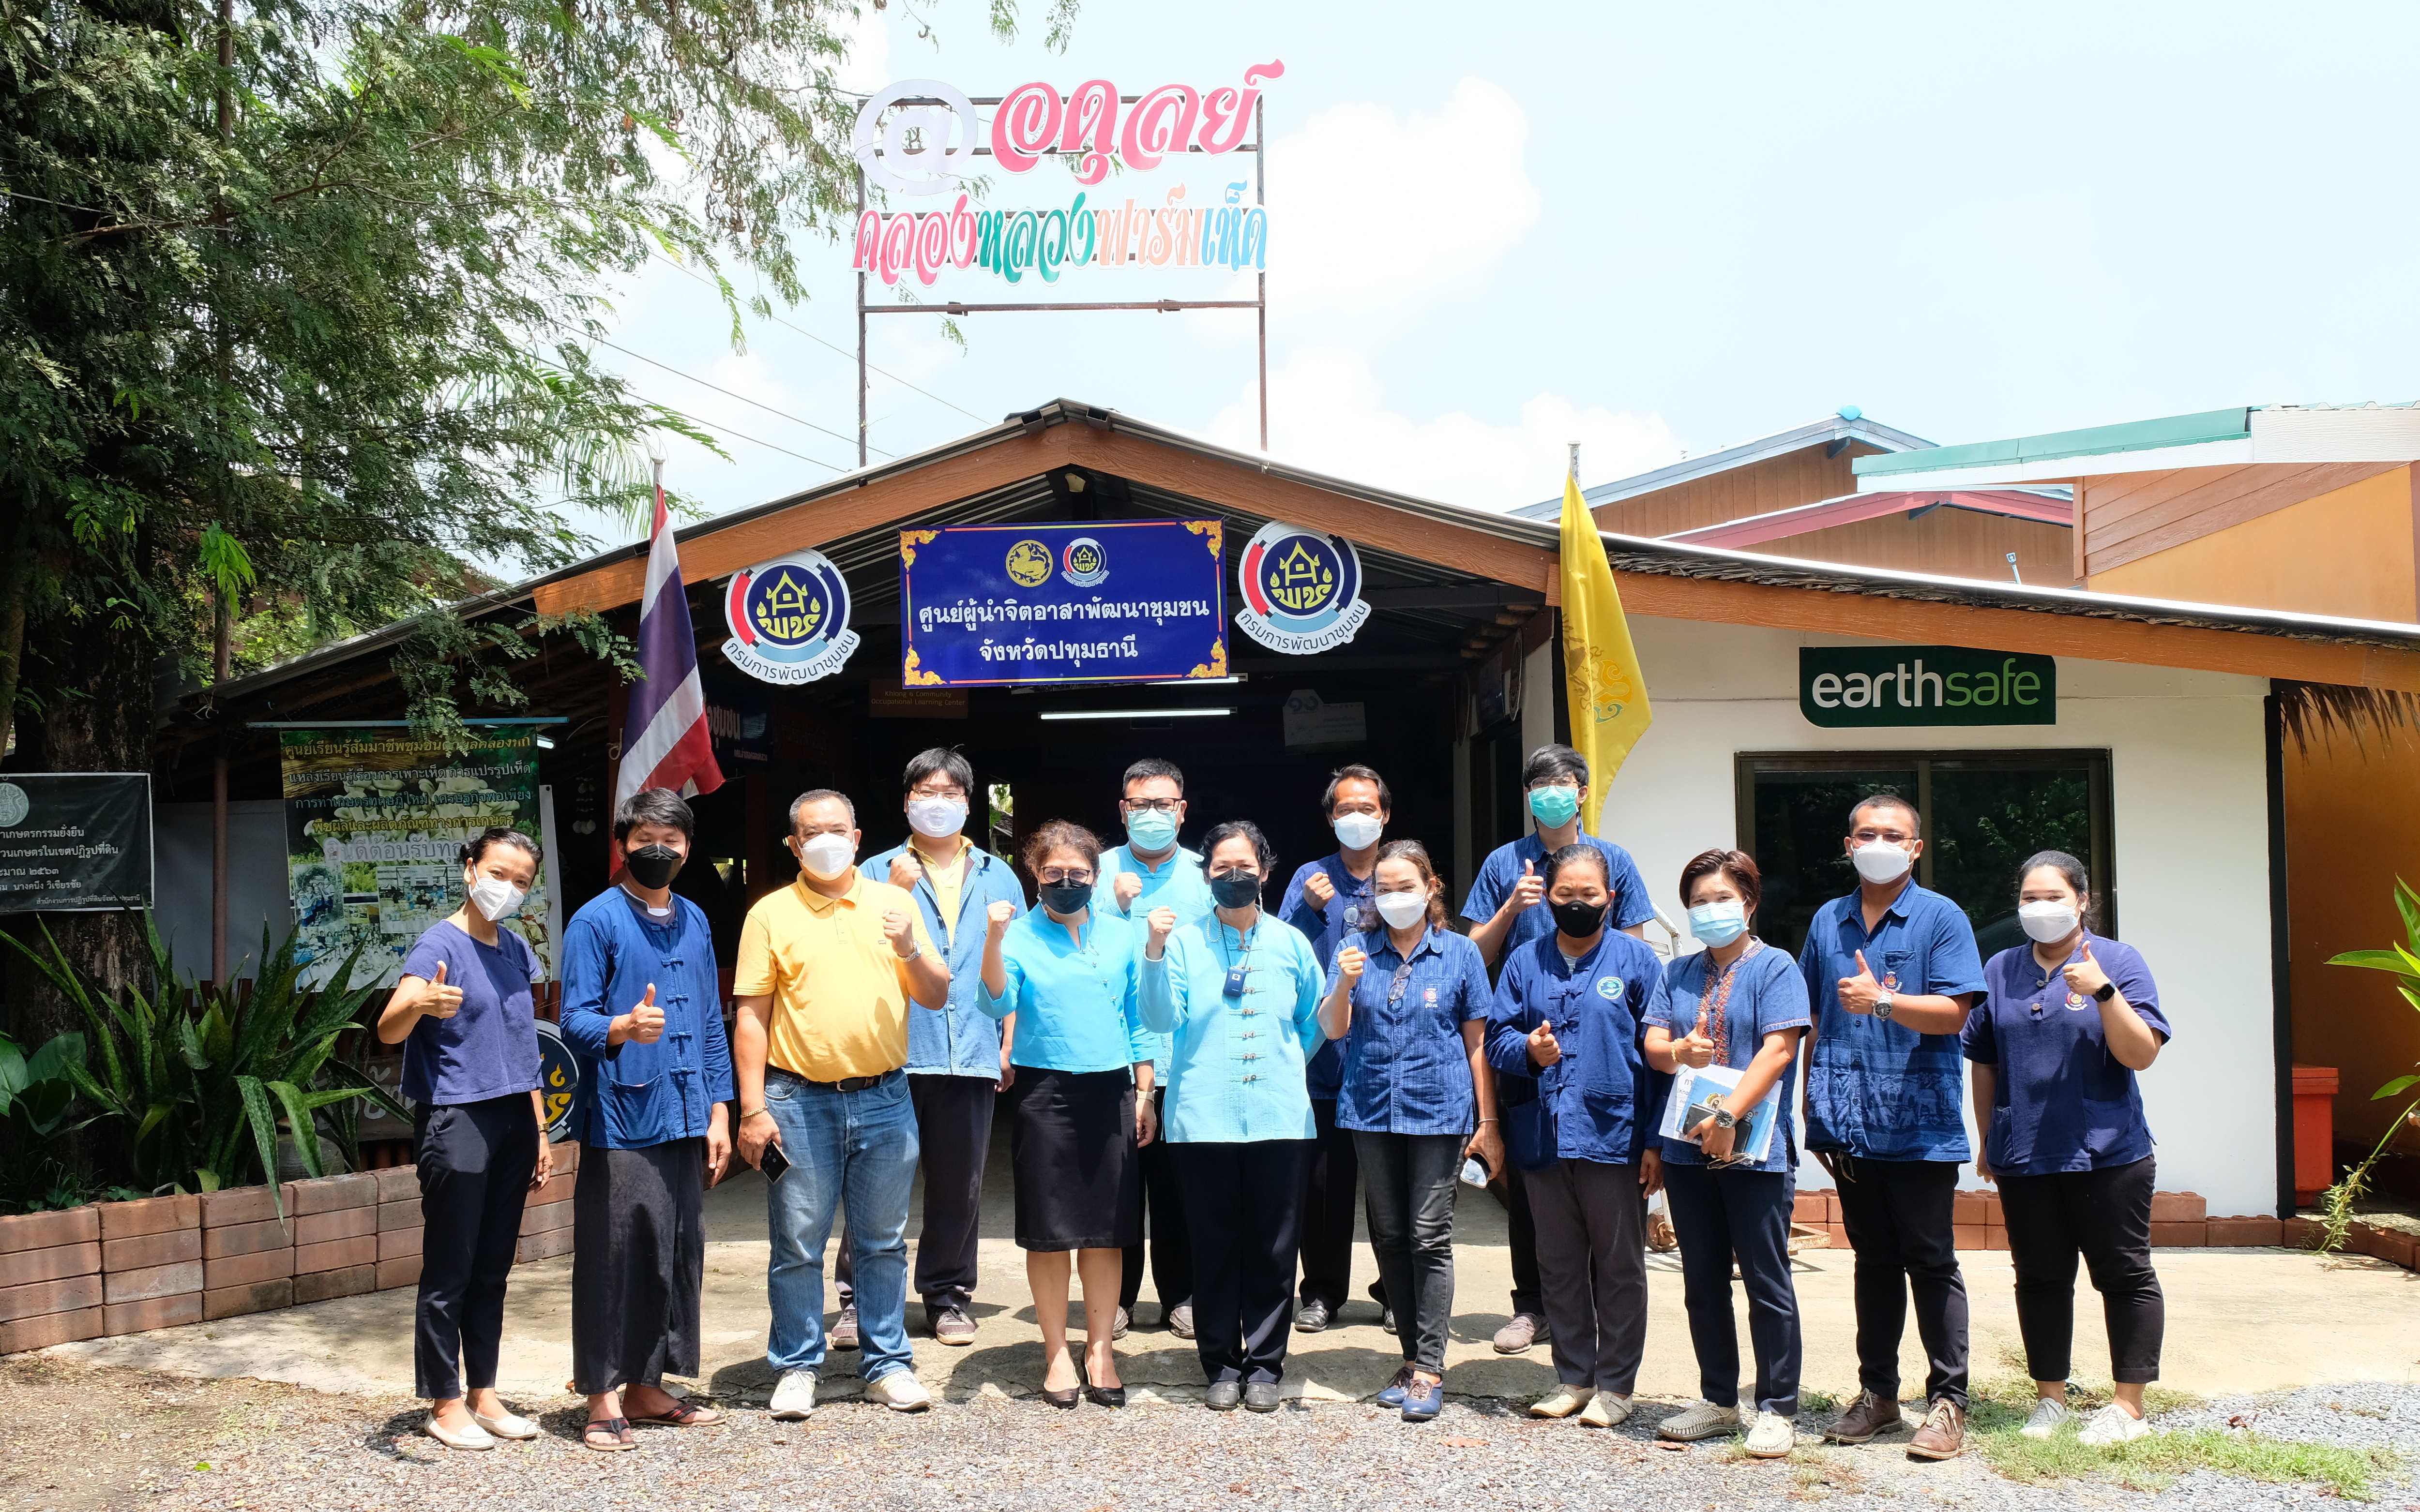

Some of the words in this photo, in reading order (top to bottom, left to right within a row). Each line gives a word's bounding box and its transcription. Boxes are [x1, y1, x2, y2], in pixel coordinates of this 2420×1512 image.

[854, 78, 978, 195] @
[991, 59, 1285, 186] อดุลย์
[852, 180, 1267, 286] คลองหลวงฟาร์มเห็ด
[1061, 570, 1109, 587] กรมการพัฒนาชุมชน
[919, 596, 1210, 631] ศูนย์ผู้นำจิตอาสาพัฒนาชุมชน
[1240, 603, 1367, 650] กรมการพัฒนาชุมชน
[726, 634, 856, 680] กรมการพัฒนาชุมชน
[979, 634, 1138, 668] จังหวัดปทุมธานี
[1812, 658, 2041, 707] earthsafe
[29, 867, 59, 875] ๒๕๖๓
[36, 894, 140, 905] สำนักงานการปฏิรูปที่ดินจังหวัปทุมธานี
